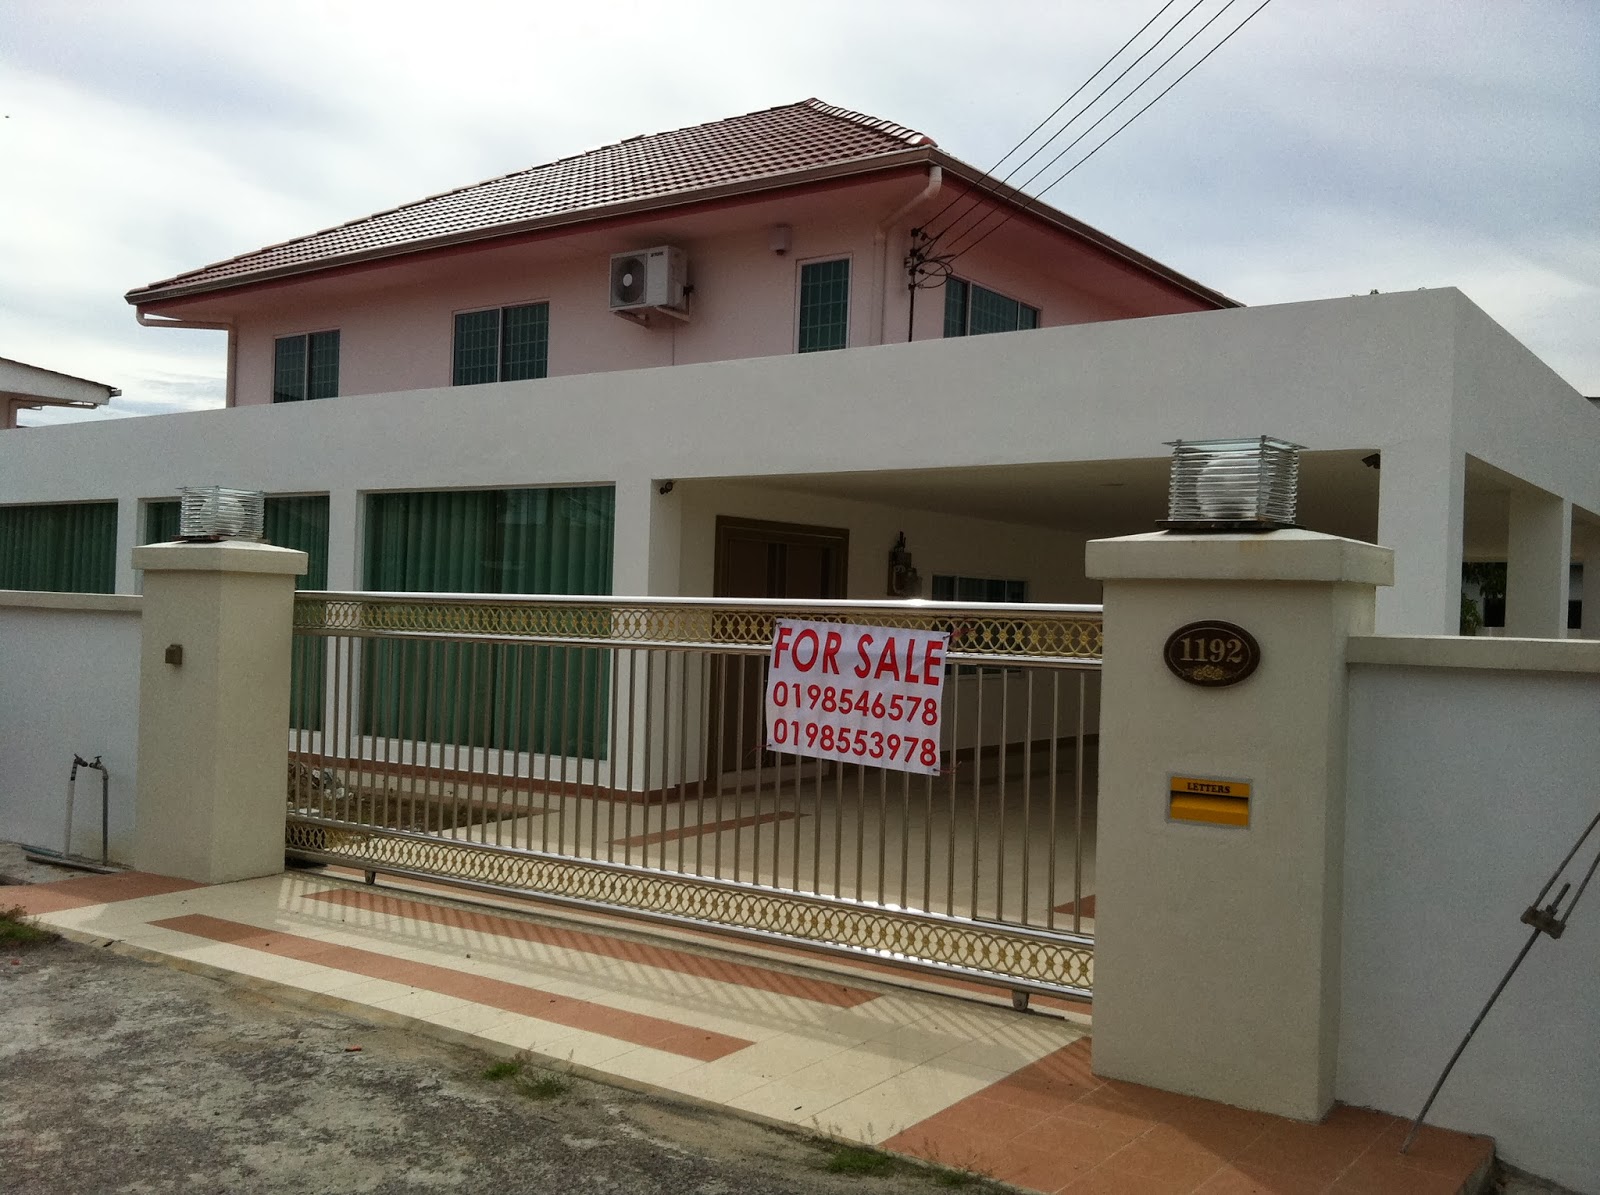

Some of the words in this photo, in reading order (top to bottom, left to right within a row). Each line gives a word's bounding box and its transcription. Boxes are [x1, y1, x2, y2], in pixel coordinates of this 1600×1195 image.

[773, 627, 842, 675] FOR
[853, 633, 944, 686] SALE
[1180, 637, 1242, 664] 1192
[772, 680, 938, 726] 0198546578
[773, 718, 937, 767] 0198553978
[1186, 782, 1231, 794] LETTERS
